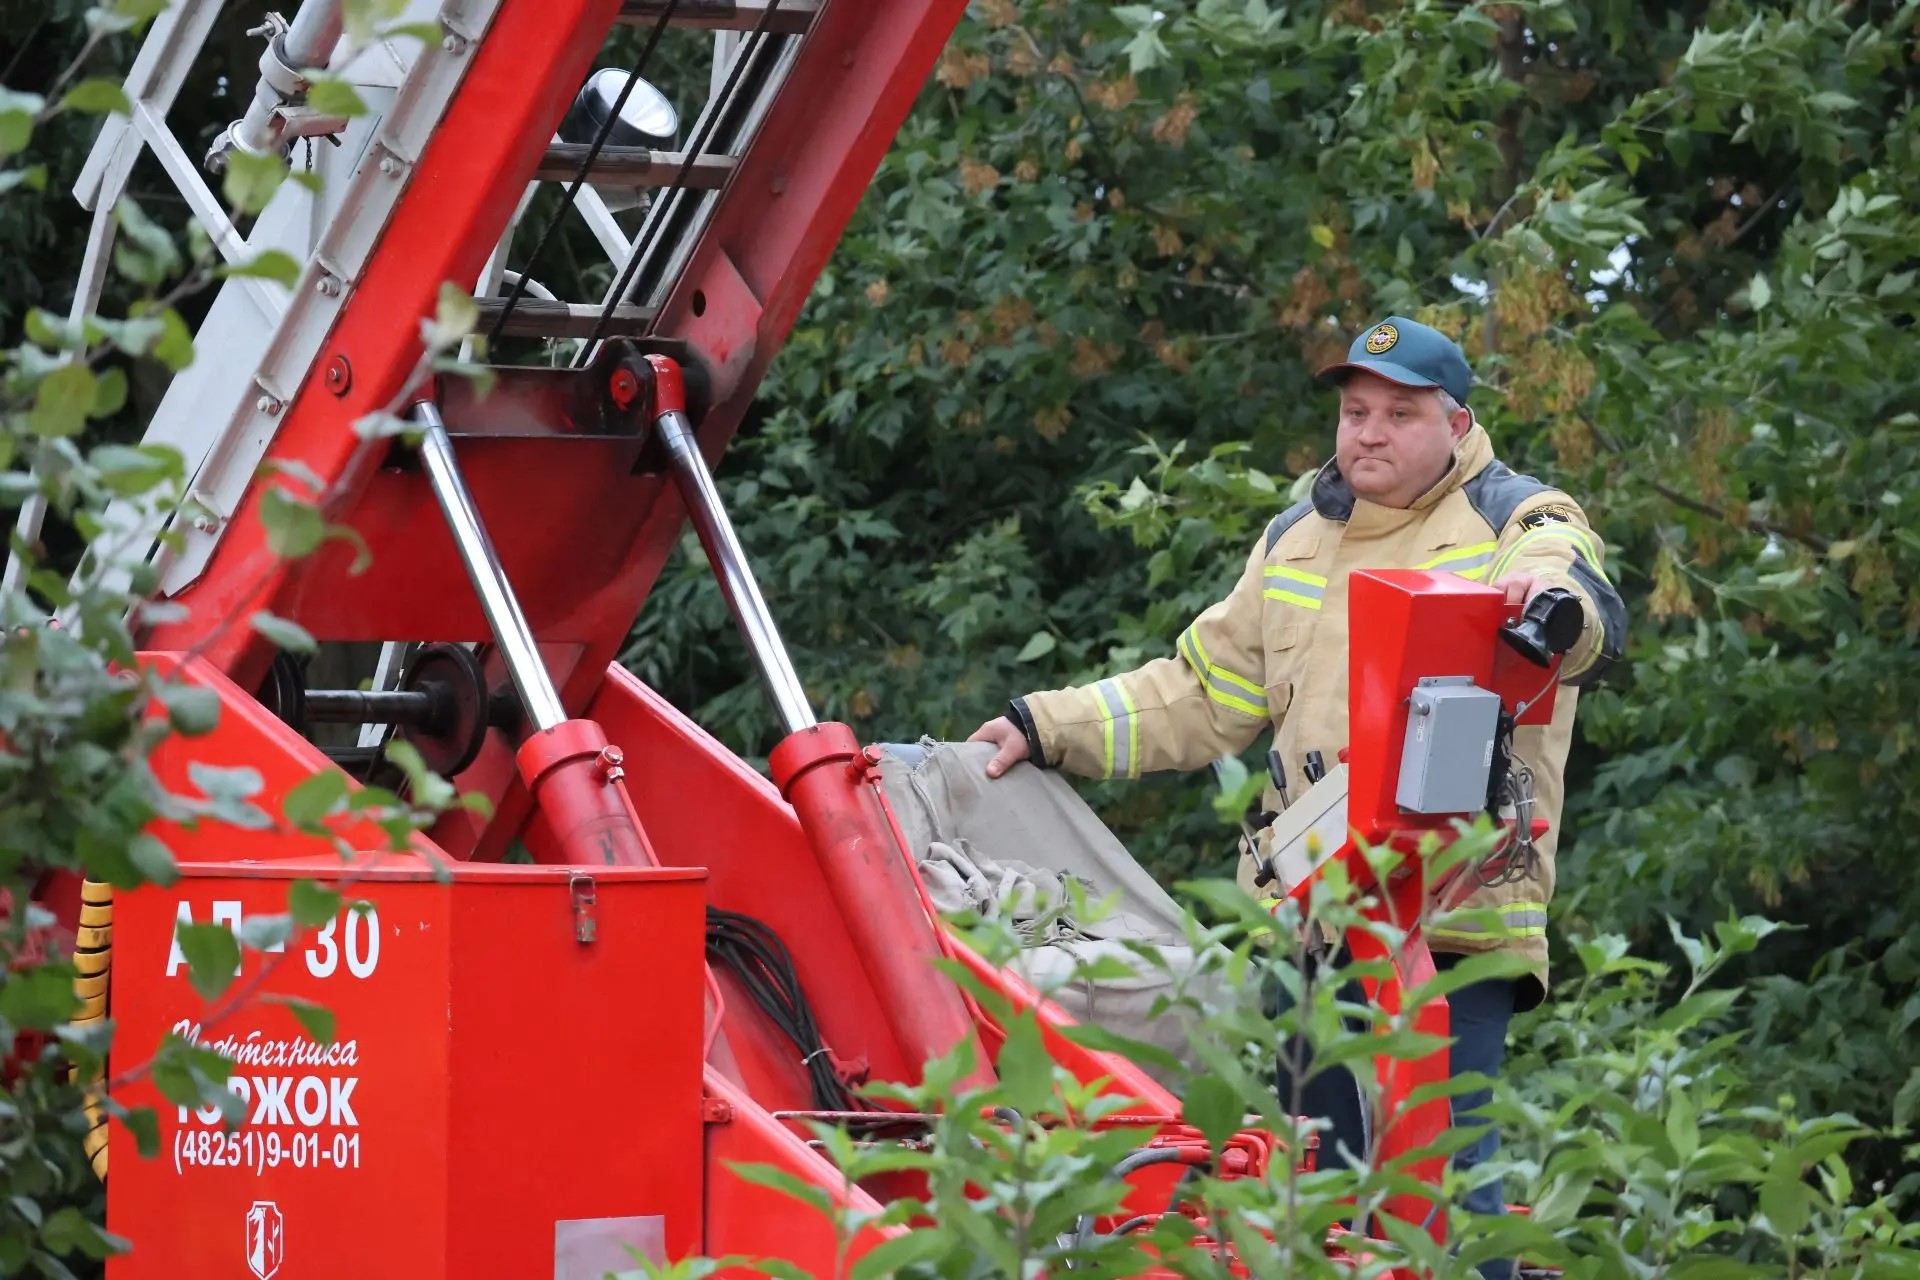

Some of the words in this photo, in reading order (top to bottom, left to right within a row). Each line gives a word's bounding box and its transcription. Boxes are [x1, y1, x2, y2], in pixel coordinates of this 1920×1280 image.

[305, 900, 380, 978] 30
[172, 1018, 359, 1067] Пжтехника
[174, 1130, 360, 1177] (48251)9-01-01
